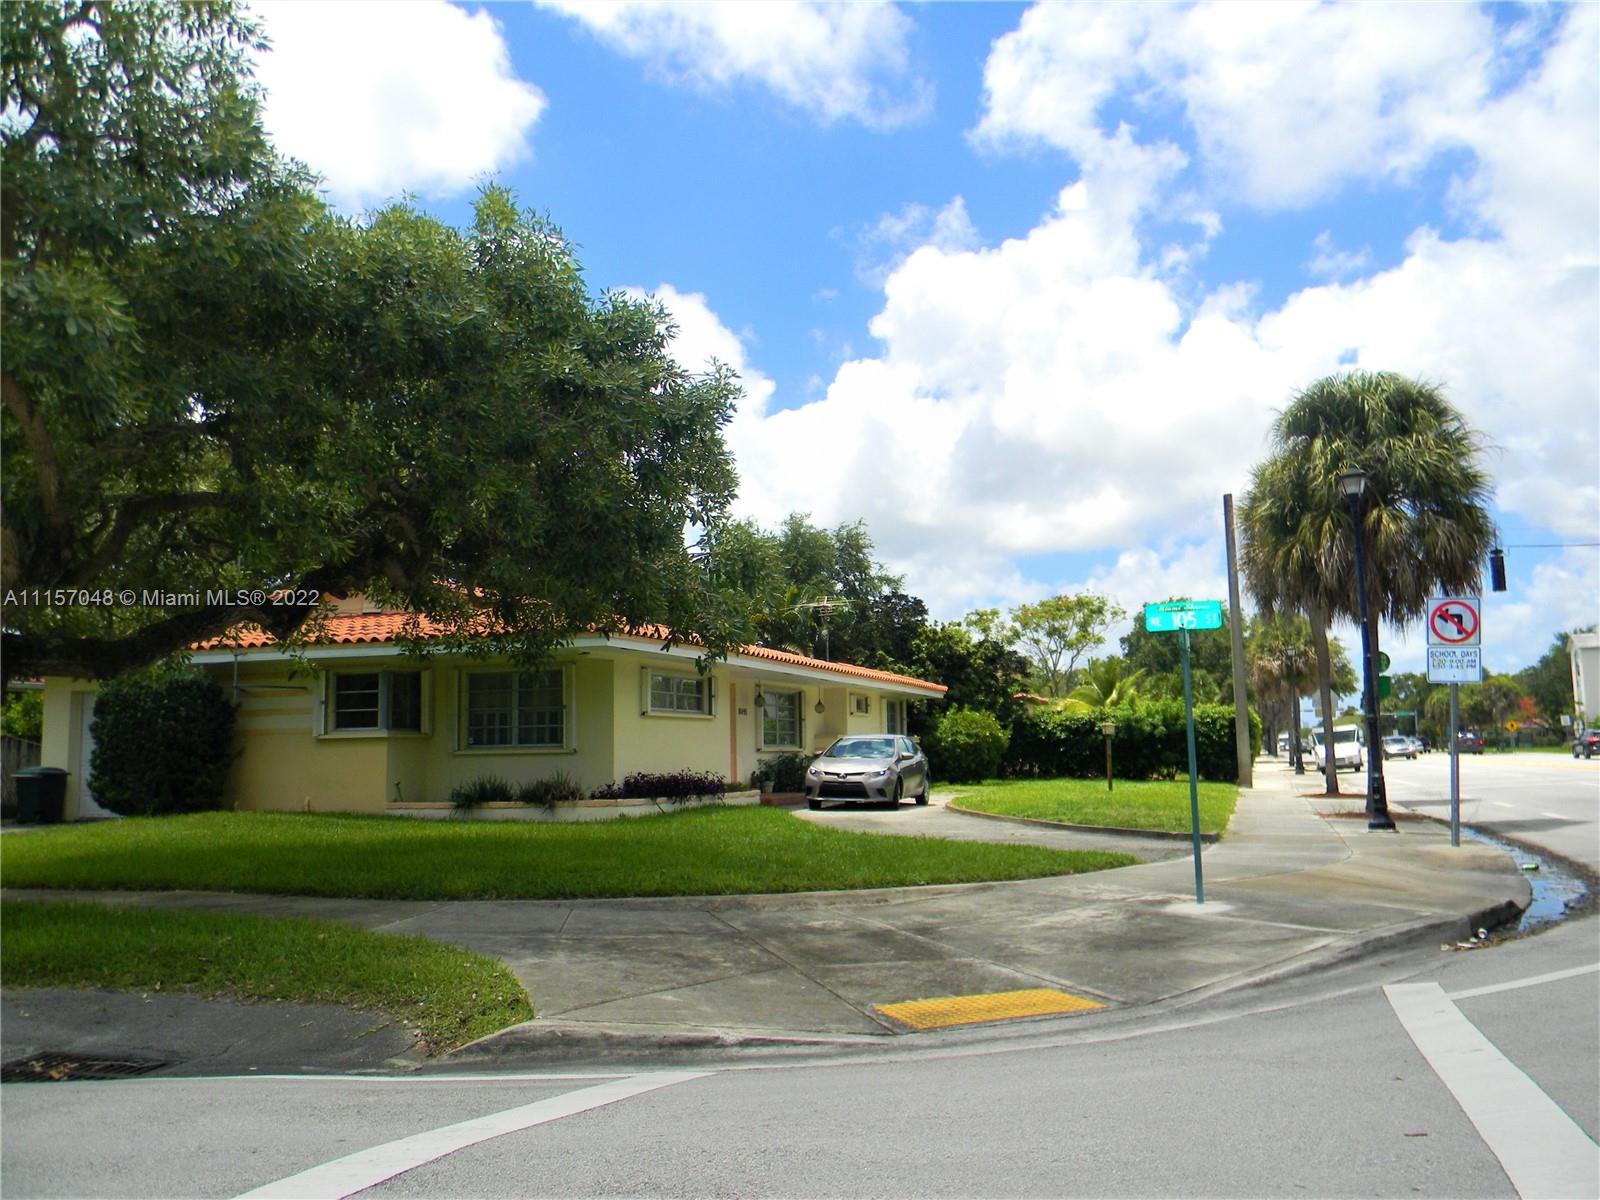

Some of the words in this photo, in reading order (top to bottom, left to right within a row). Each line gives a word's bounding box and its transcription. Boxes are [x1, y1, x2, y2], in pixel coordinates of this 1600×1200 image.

[1171, 611, 1197, 629] 105
[1430, 650, 1457, 658] SCHOOL
[1460, 650, 1478, 658] DAYS
